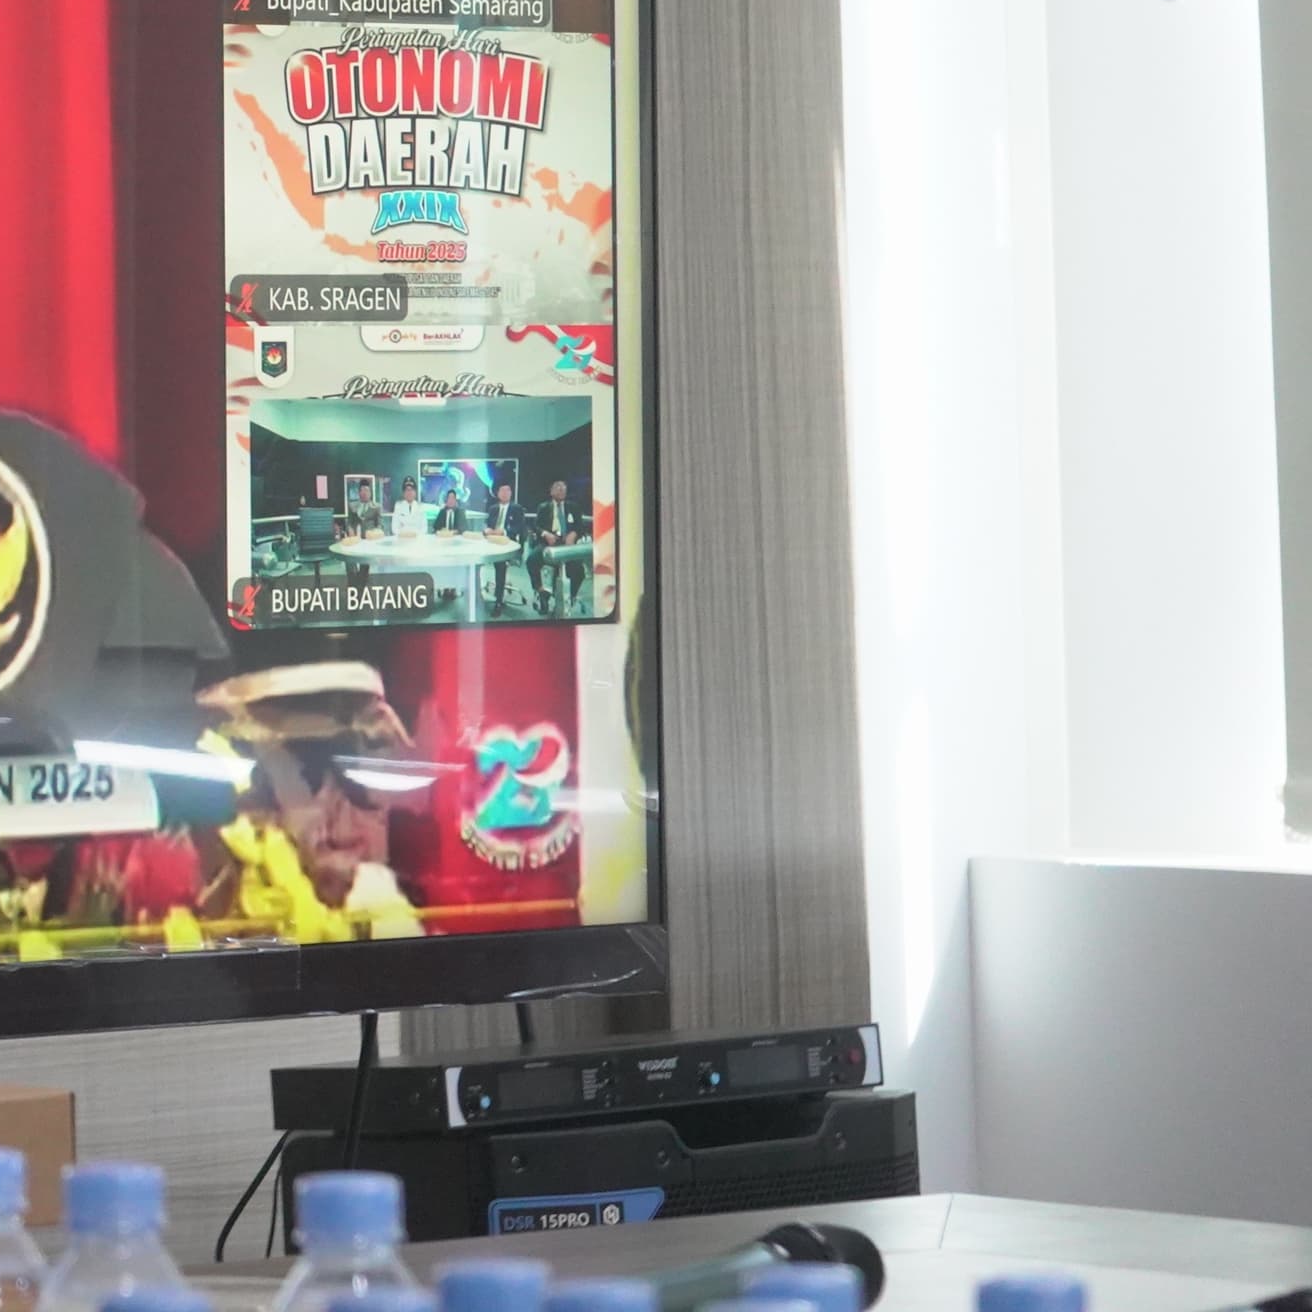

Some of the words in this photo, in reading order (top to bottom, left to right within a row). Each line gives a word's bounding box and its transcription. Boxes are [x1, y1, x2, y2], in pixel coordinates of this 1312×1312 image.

[284, 47, 551, 131] OTONOMI
[307, 117, 529, 197] DAERAH
[371, 189, 469, 235] XXIX
[376, 240, 426, 263] Tahun
[426, 240, 468, 262] 2025
[269, 288, 314, 310] KAB.
[320, 287, 401, 311] SRAGEN
[271, 587, 341, 613] BUPATI
[347, 584, 428, 611] BATANG
[29, 761, 114, 803] 2025
[504, 1215, 535, 1231] DSR
[539, 1212, 590, 1230] 15PRO
